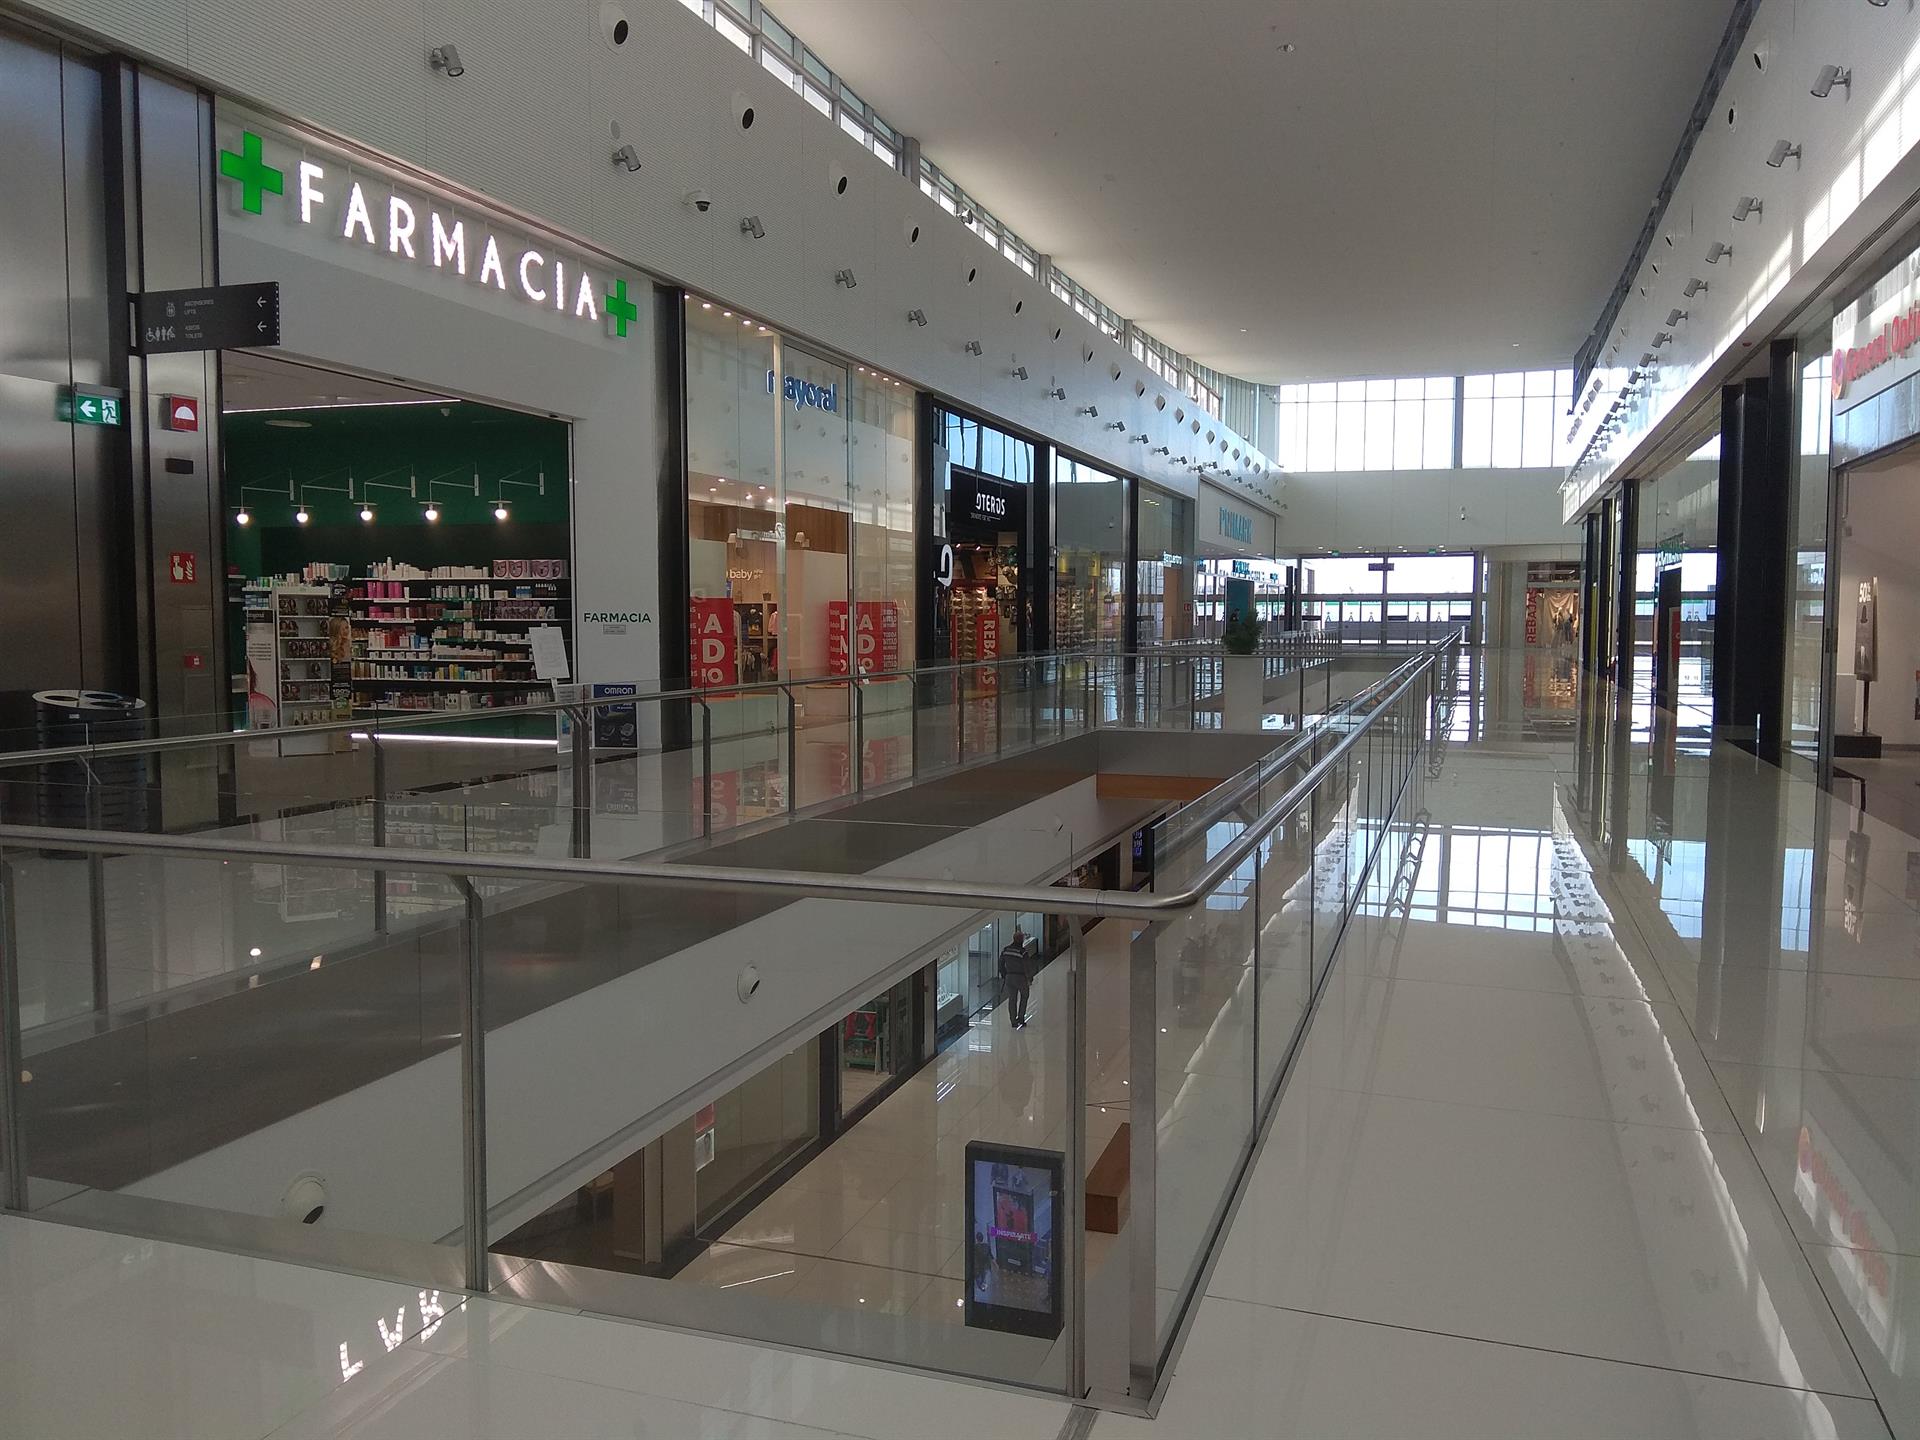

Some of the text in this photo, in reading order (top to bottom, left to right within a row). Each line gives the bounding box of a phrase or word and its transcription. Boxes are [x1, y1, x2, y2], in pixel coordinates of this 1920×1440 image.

[298, 160, 599, 321] FARMACIA
[975, 492, 1006, 516] OTEROS
[729, 568, 753, 581] baby
[583, 612, 652, 623] FARMACIA
[982, 619, 997, 686] REBAAS
[604, 687, 633, 695] OMRON
